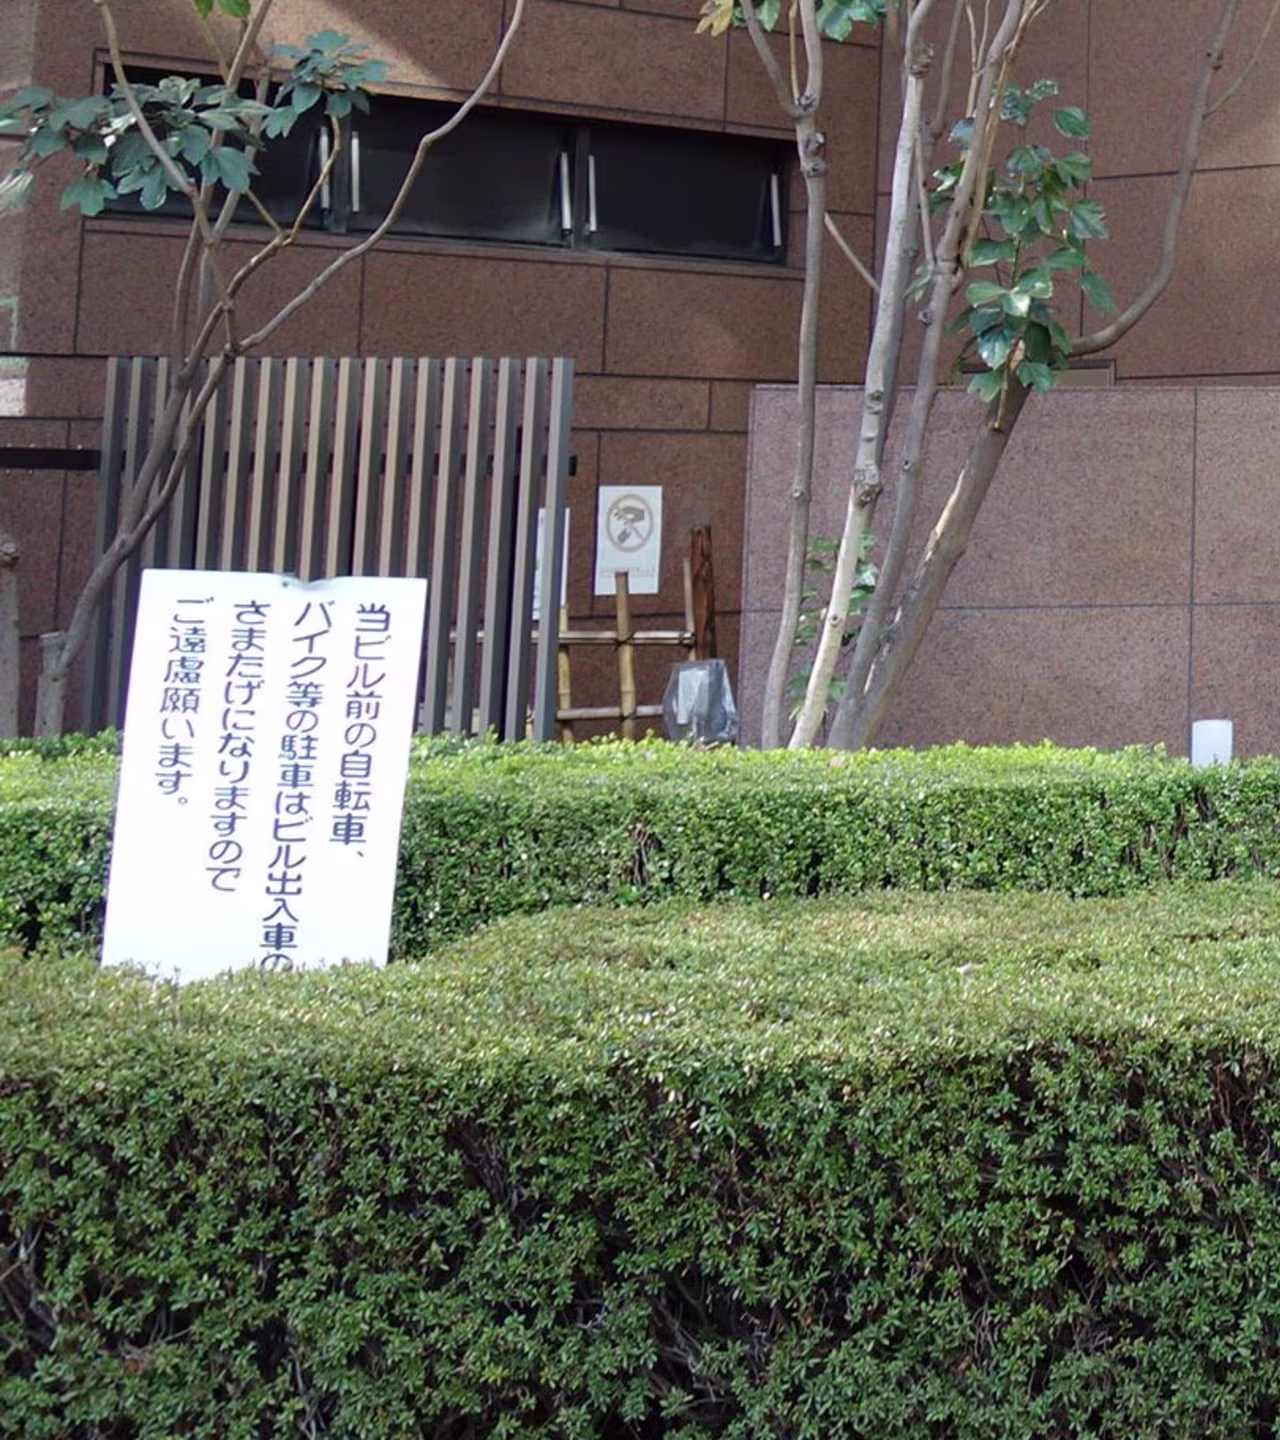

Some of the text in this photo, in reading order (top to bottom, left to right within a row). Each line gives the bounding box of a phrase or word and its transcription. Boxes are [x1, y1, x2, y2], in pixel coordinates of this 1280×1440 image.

[154, 596, 215, 805] ご遠慮願います。
[205, 600, 271, 892] さまたげになりますので
[328, 603, 391, 858] 当ビル前の自転車、
